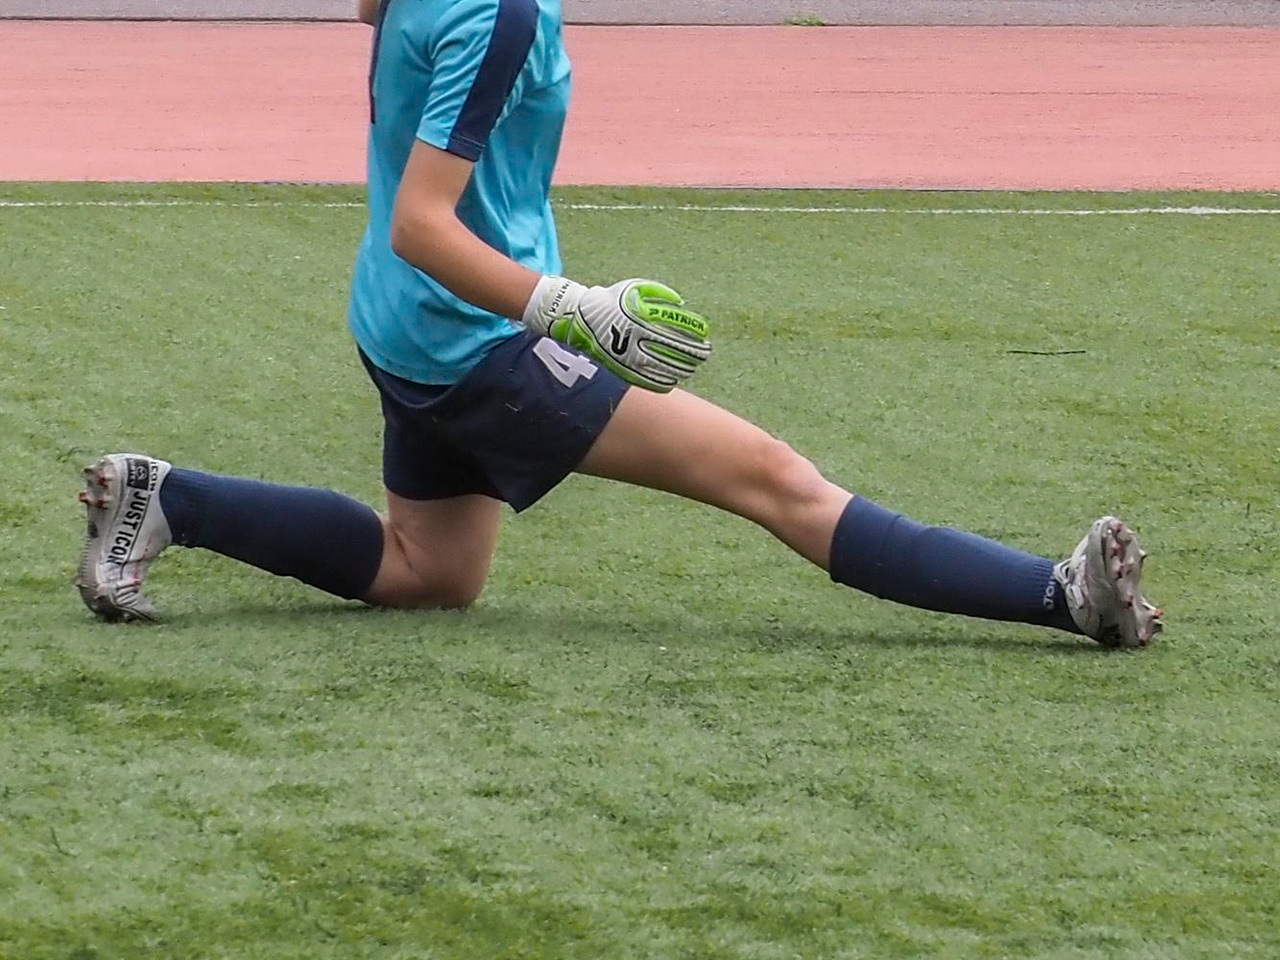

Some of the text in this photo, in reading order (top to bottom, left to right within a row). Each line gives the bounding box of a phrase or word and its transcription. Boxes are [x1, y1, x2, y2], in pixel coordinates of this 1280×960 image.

[661, 310, 705, 332] PATRICK
[532, 336, 599, 388] 4
[106, 490, 147, 566] JUST ICON
